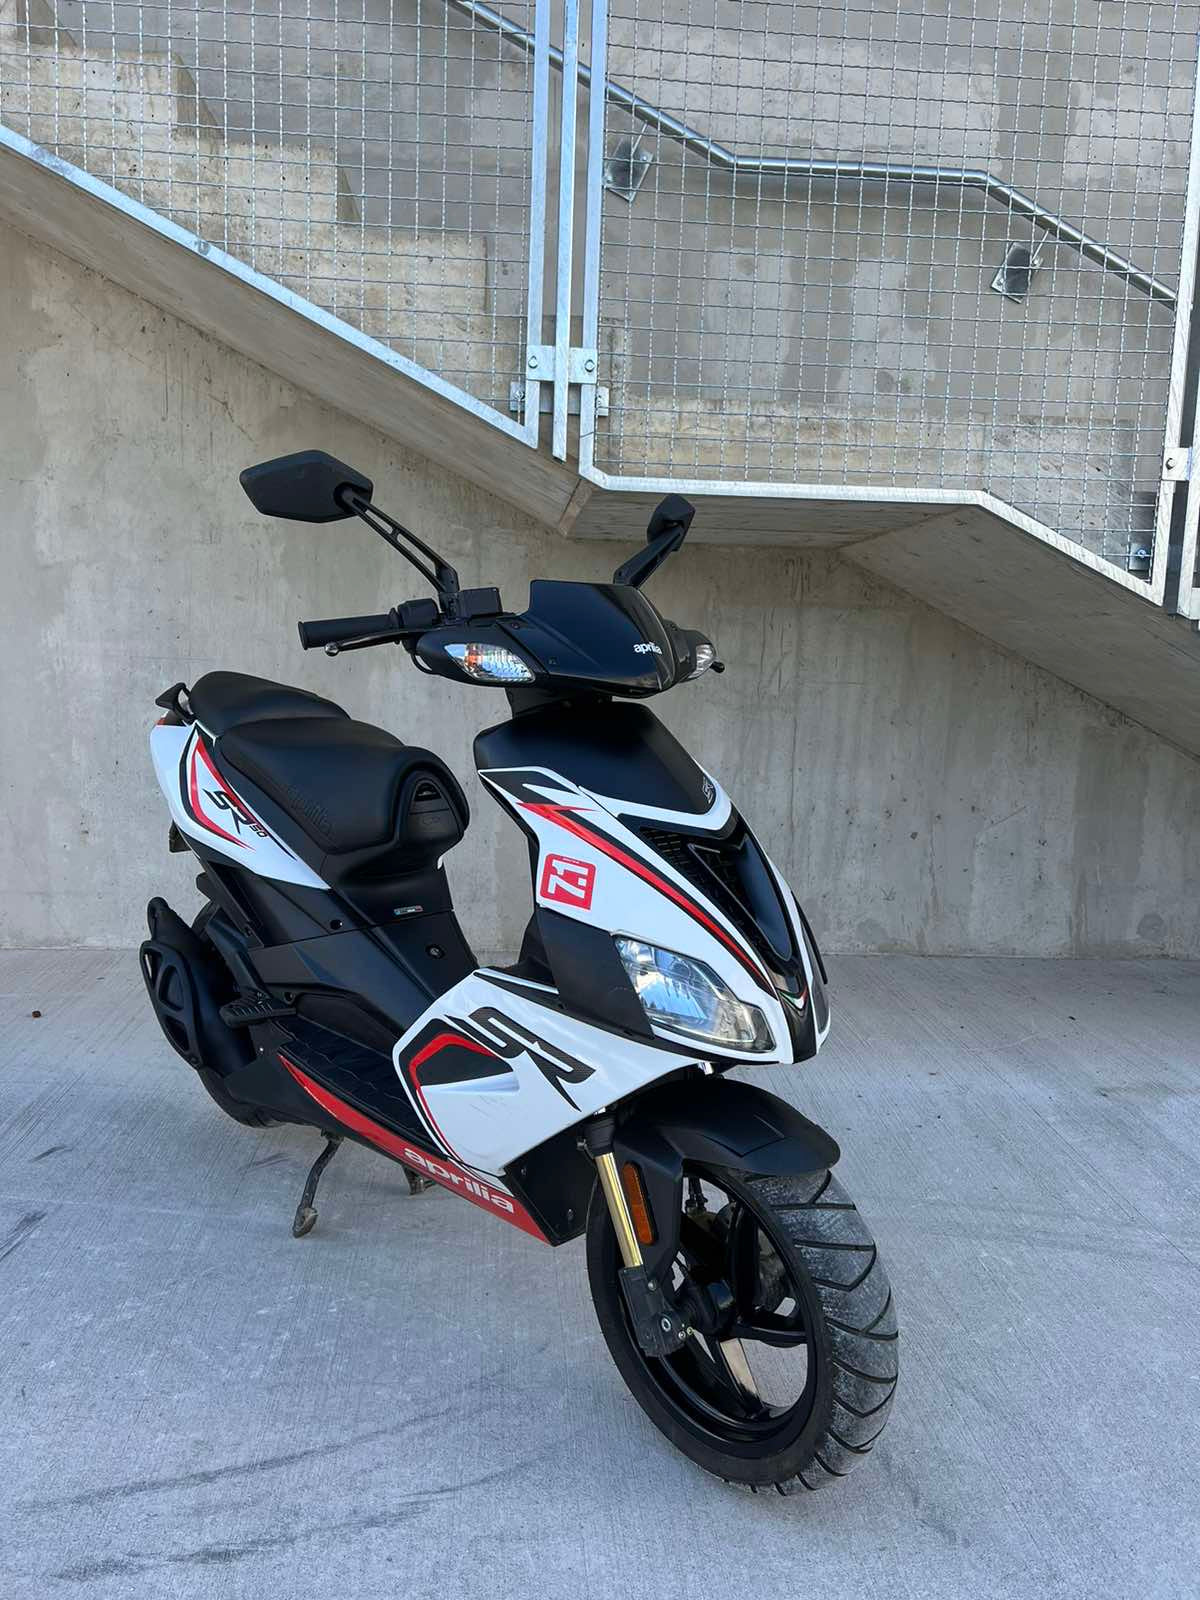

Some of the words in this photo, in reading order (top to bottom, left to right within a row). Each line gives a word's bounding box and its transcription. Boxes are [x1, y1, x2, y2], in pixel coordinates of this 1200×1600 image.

[202, 788, 253, 835] SR
[249, 823, 269, 838] 50
[444, 1006, 597, 1112] SR
[403, 1147, 514, 1213] aprilia
